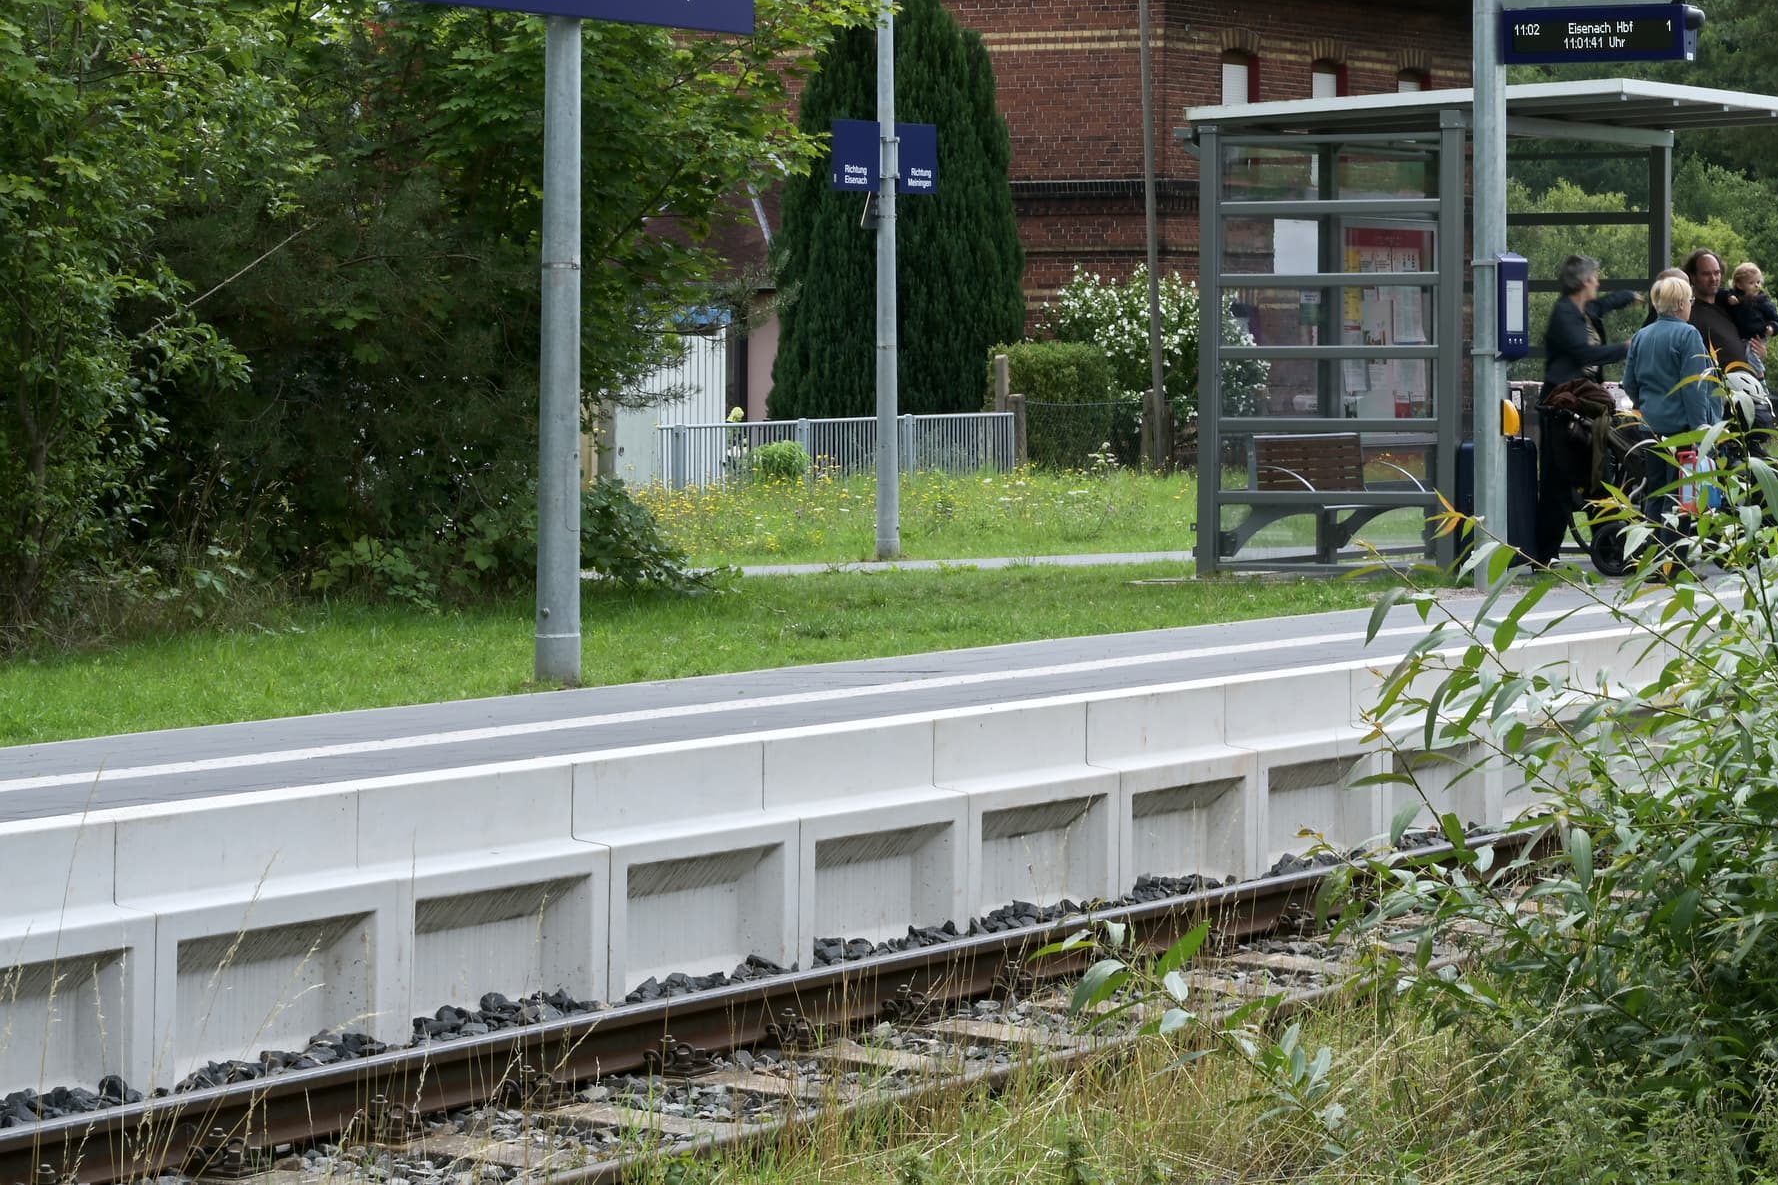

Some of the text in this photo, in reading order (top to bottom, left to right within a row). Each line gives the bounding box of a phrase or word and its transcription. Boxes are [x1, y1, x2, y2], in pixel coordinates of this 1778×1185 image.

[1514, 20, 1672, 36] 11:02 Eisenach Hbf 1
[1563, 36, 1626, 49] 11:01:41 Uhr
[844, 164, 868, 175] Richtung
[911, 167, 932, 179] Richtung
[844, 175, 868, 184] Eisenach
[907, 178, 932, 189] Meiningen
